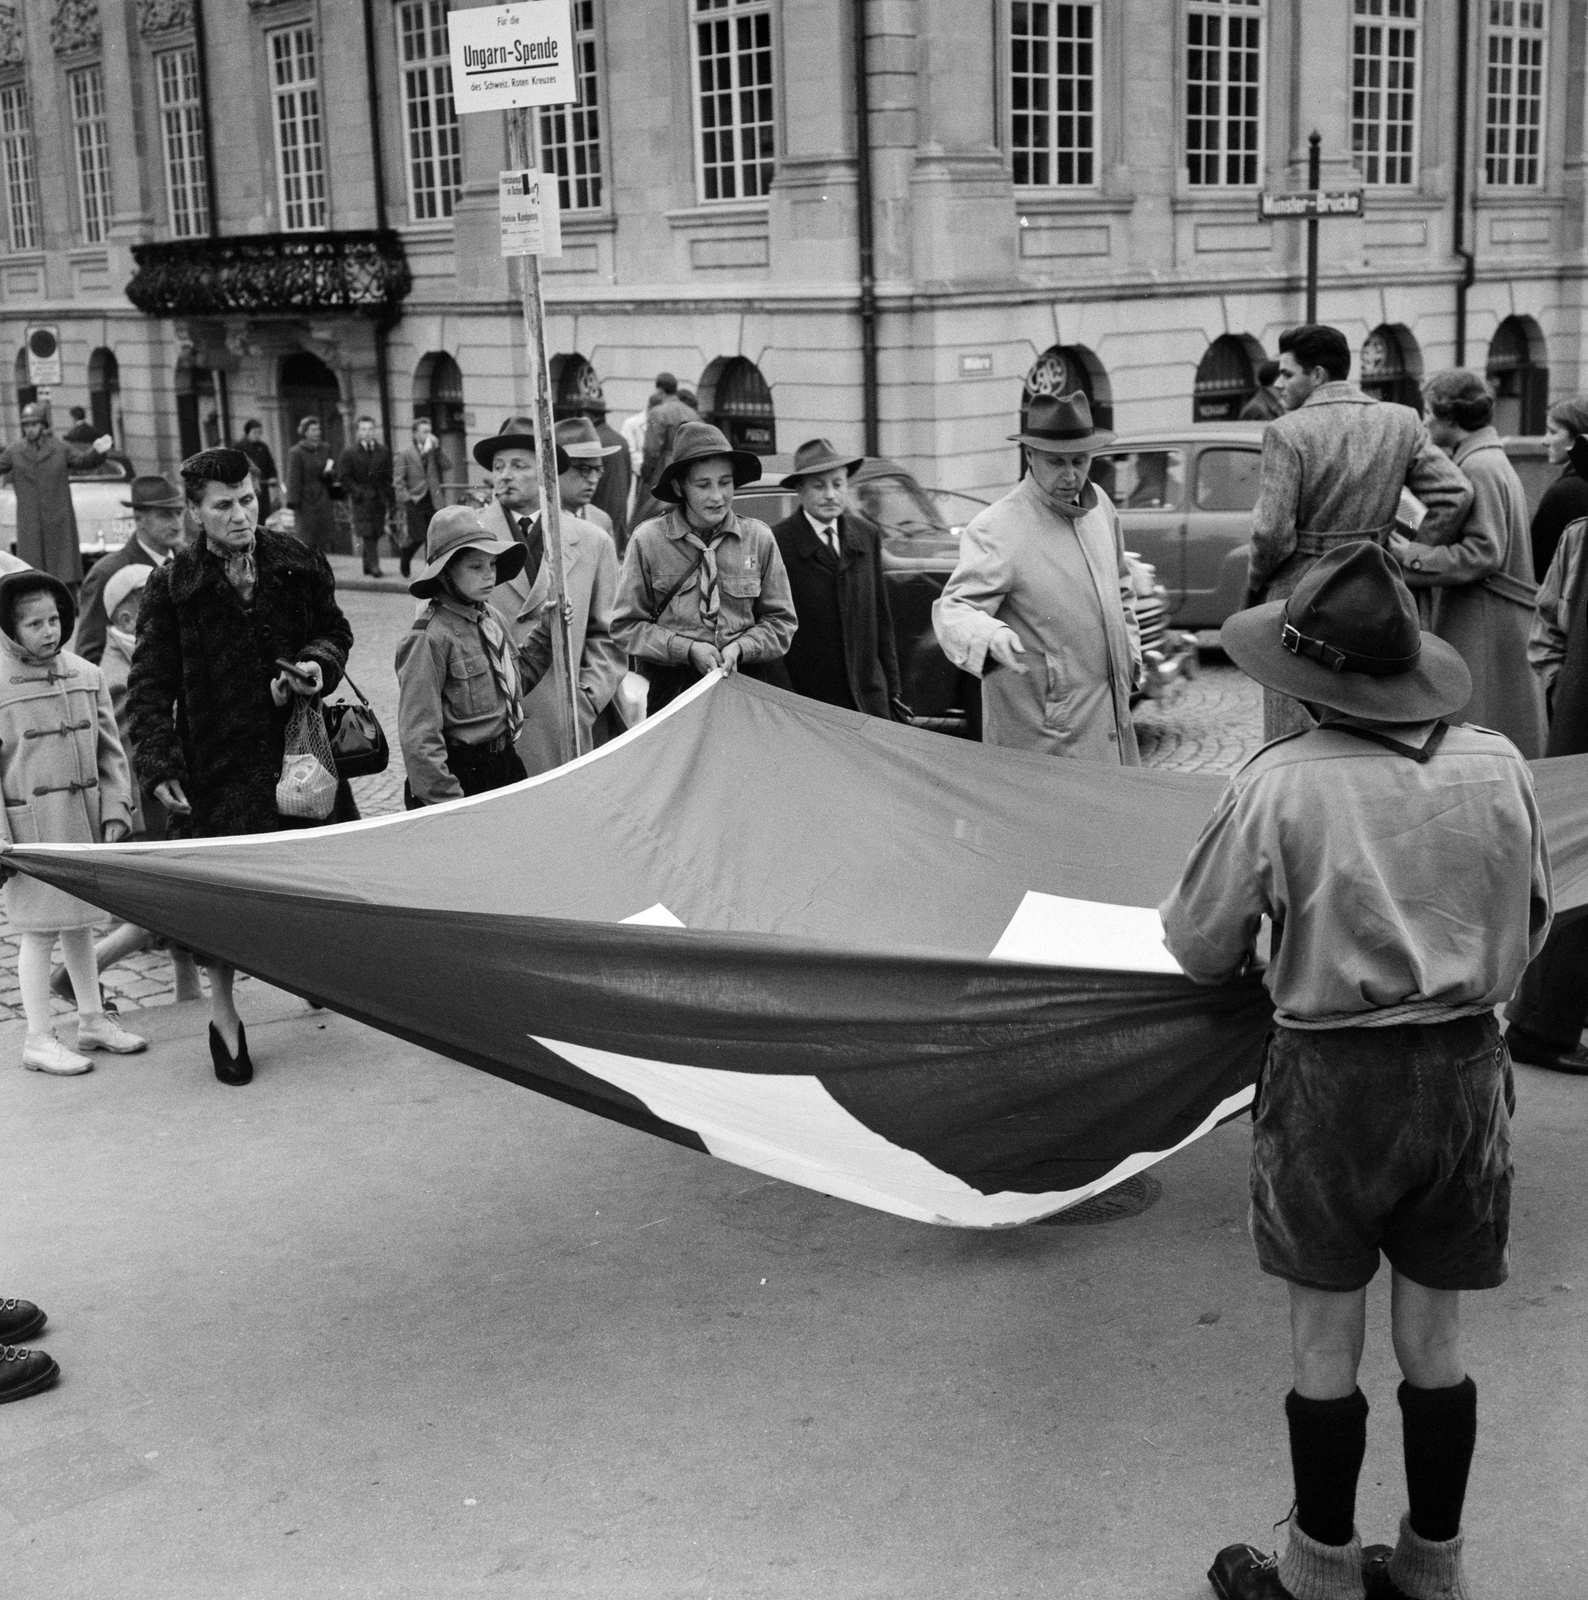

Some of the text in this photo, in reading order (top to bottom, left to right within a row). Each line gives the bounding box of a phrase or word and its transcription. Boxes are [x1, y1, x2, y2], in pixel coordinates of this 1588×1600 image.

[497, 15, 520, 26] Für die
[463, 36, 558, 69] Ungarn-Spende
[470, 76, 557, 91] des Schweiz. Roten Kreuzes
